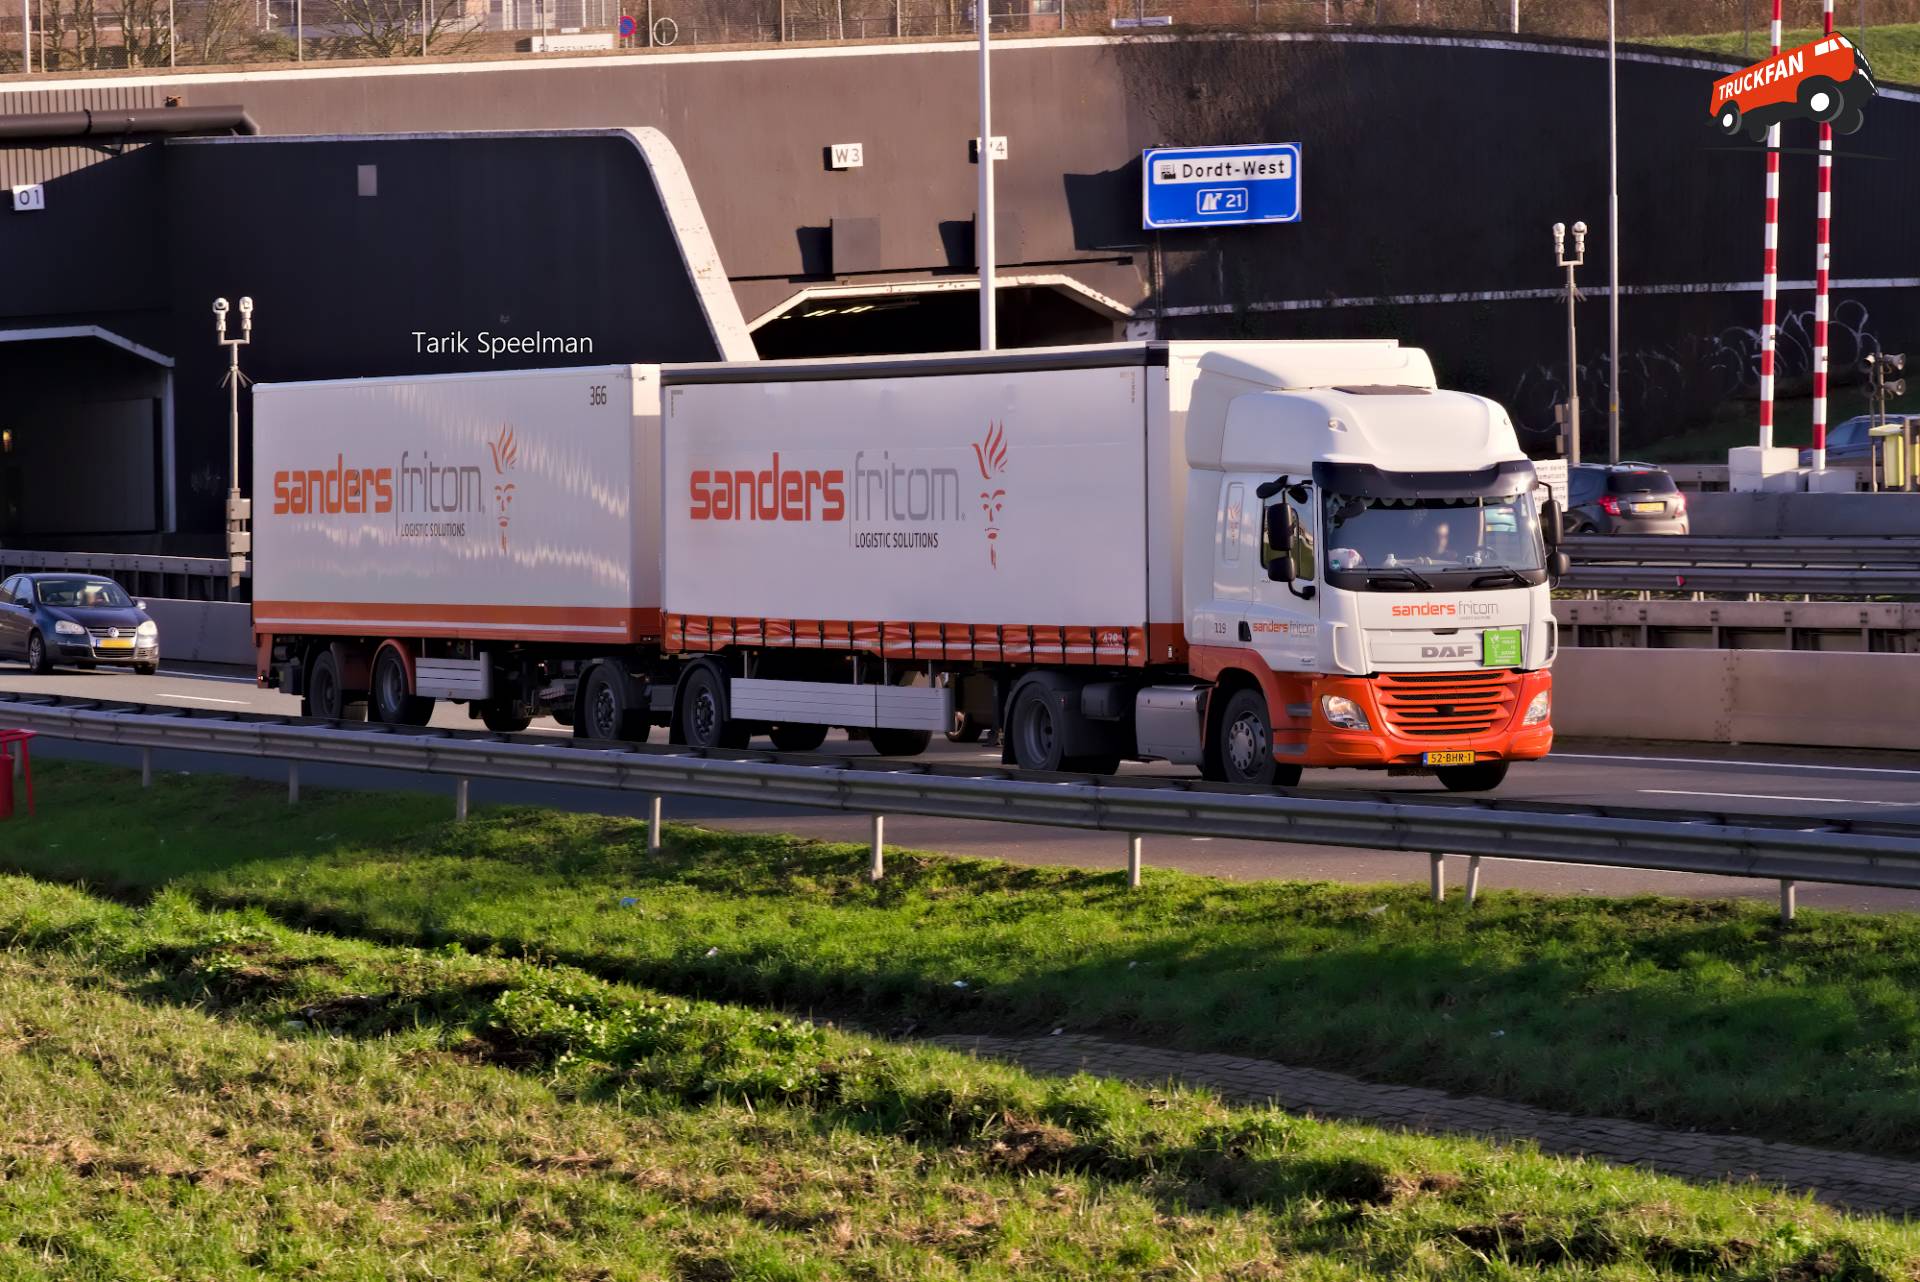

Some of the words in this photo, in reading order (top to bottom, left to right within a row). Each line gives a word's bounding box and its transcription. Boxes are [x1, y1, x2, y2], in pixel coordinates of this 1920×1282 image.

[1182, 159, 1286, 178] Dordt-West
[1225, 193, 1242, 208] 21
[589, 385, 607, 406] 366
[273, 452, 393, 515] sanders
[401, 450, 482, 513] fritom
[690, 451, 845, 522] sanders
[855, 450, 960, 521] fritom
[400, 522, 429, 538] LOGISTIC
[429, 522, 466, 537] SOLUTIONS
[855, 531, 891, 549] LOGISTIC
[892, 531, 939, 549] SOLUTIONS
[1391, 601, 1456, 617] sanders
[1252, 620, 1289, 633] sanders
[1421, 645, 1474, 658] DAF
[1431, 752, 1472, 764] 52-BHR-1
